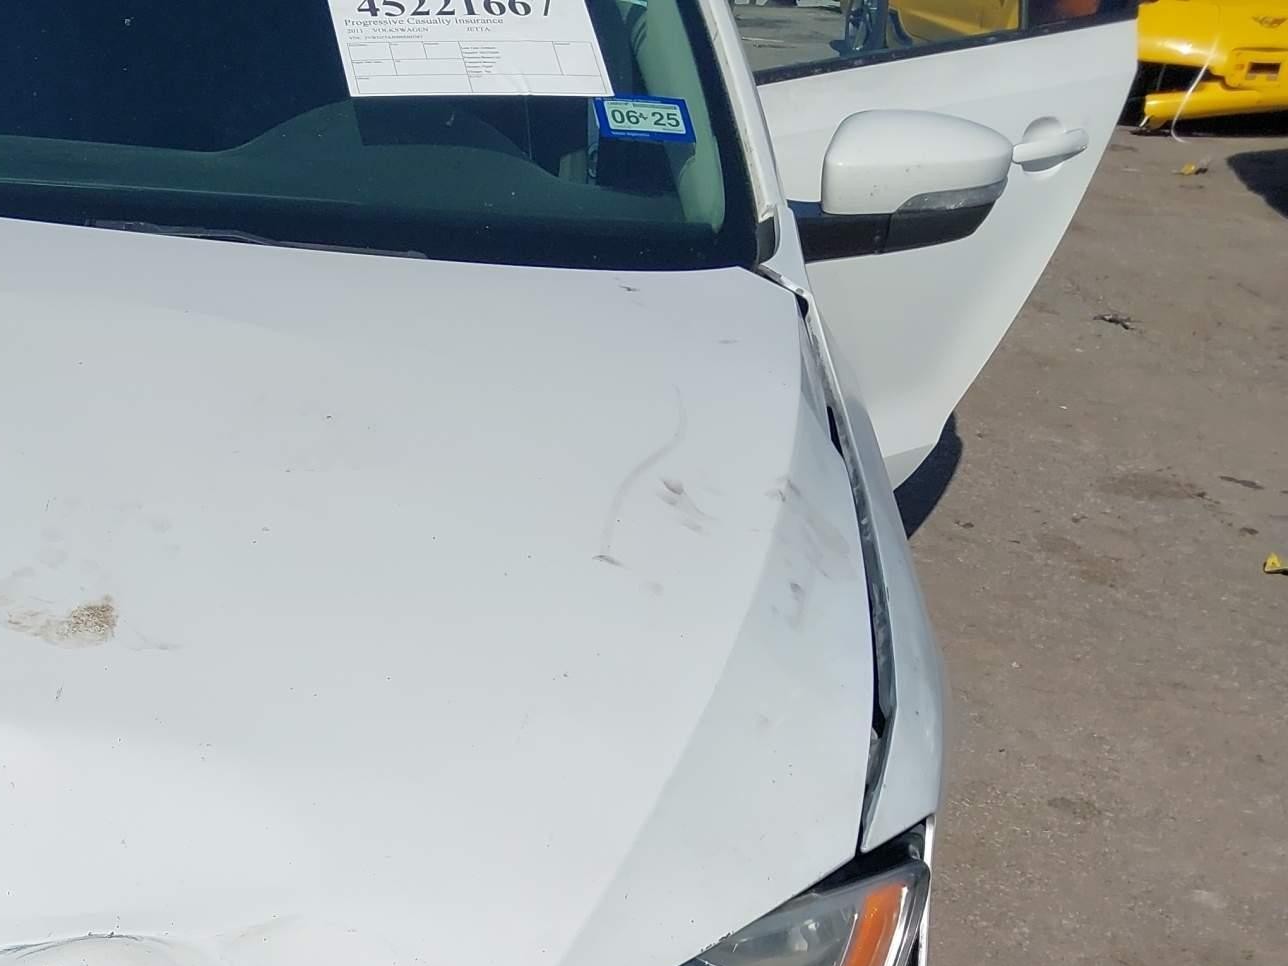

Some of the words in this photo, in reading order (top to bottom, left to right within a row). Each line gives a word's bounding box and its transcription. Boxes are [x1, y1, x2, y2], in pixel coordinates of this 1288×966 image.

[344, 17, 404, 27] Progressive
[406, 16, 451, 26] Casualty
[454, 16, 503, 25] Insurance
[611, 109, 640, 125] 06
[651, 111, 681, 127] 25
